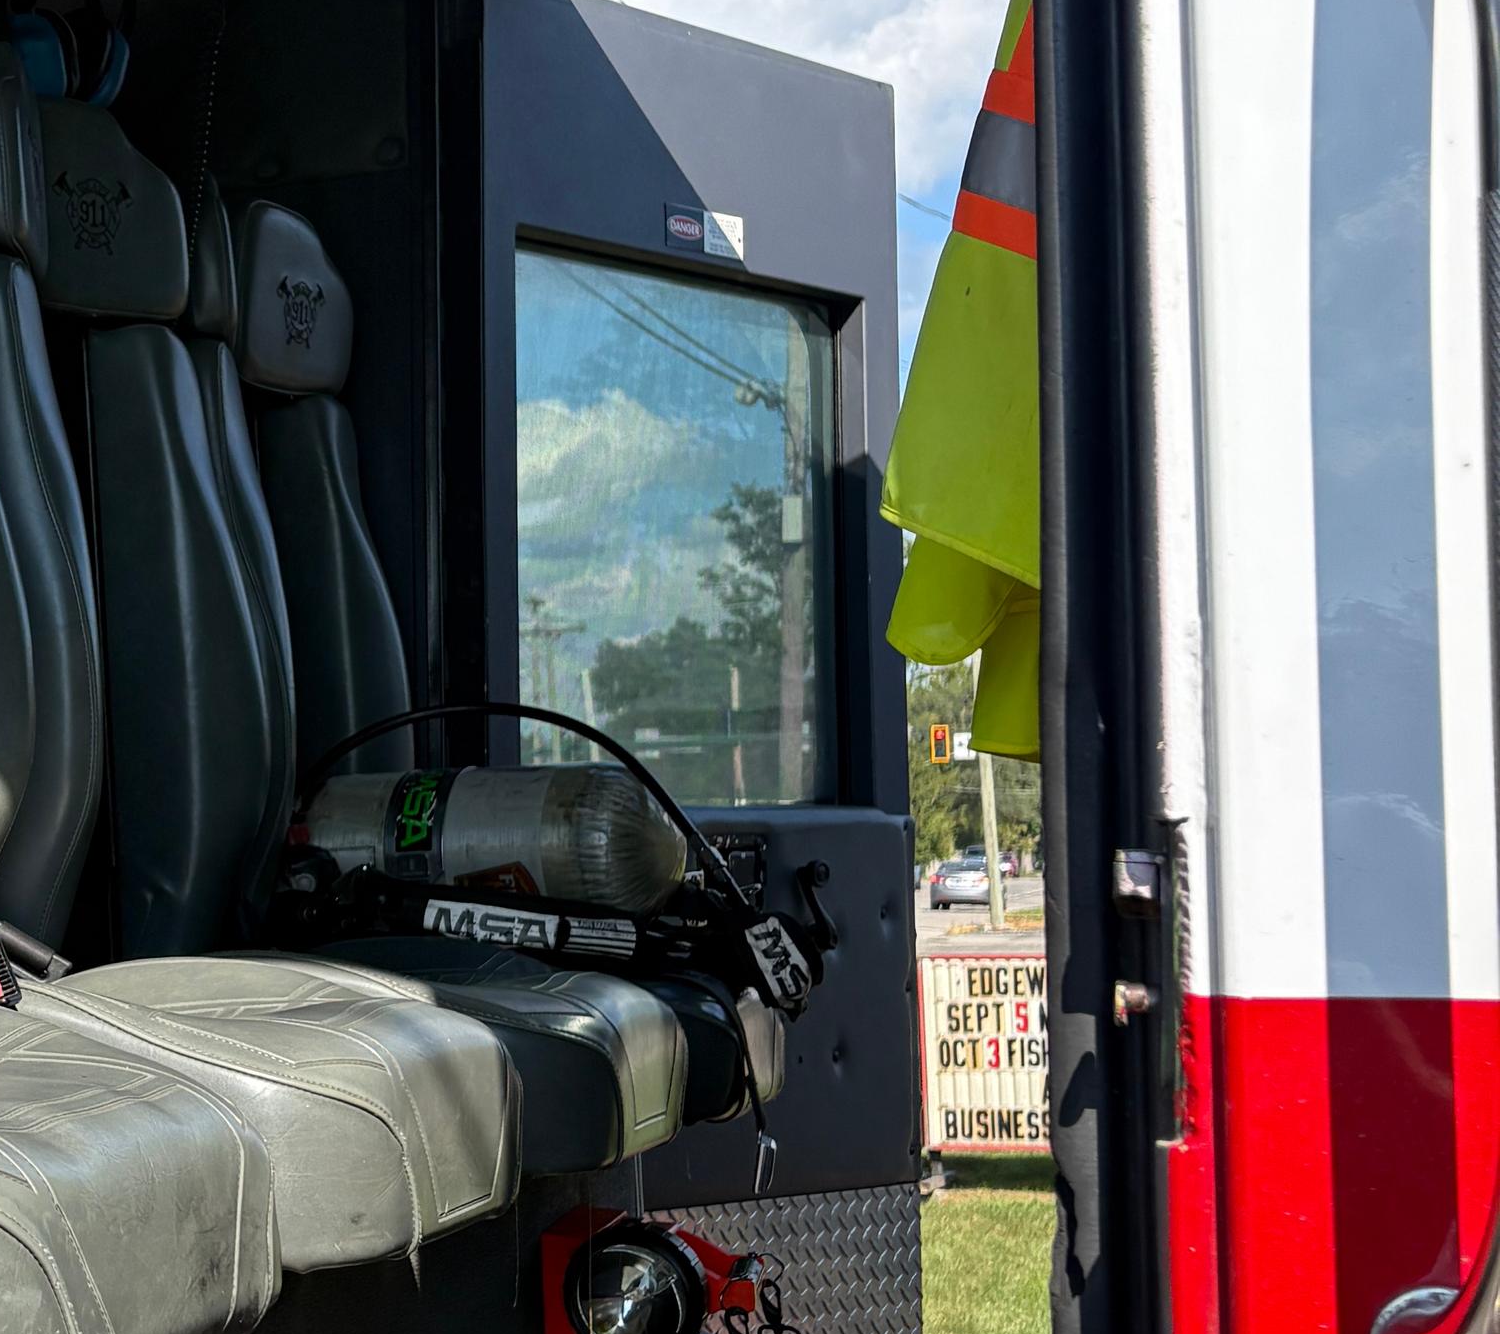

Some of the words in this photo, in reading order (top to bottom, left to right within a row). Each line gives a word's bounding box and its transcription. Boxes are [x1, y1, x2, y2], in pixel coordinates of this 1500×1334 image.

[79, 199, 106, 228] 911
[670, 219, 700, 236] DANGER
[291, 300, 309, 326] 911
[432, 907, 552, 950] MSA
[947, 1002, 1004, 1033] SEPT
[1015, 1002, 1029, 1033] 5
[939, 1039, 982, 1068] OCT
[987, 1038, 1001, 1068] 3
